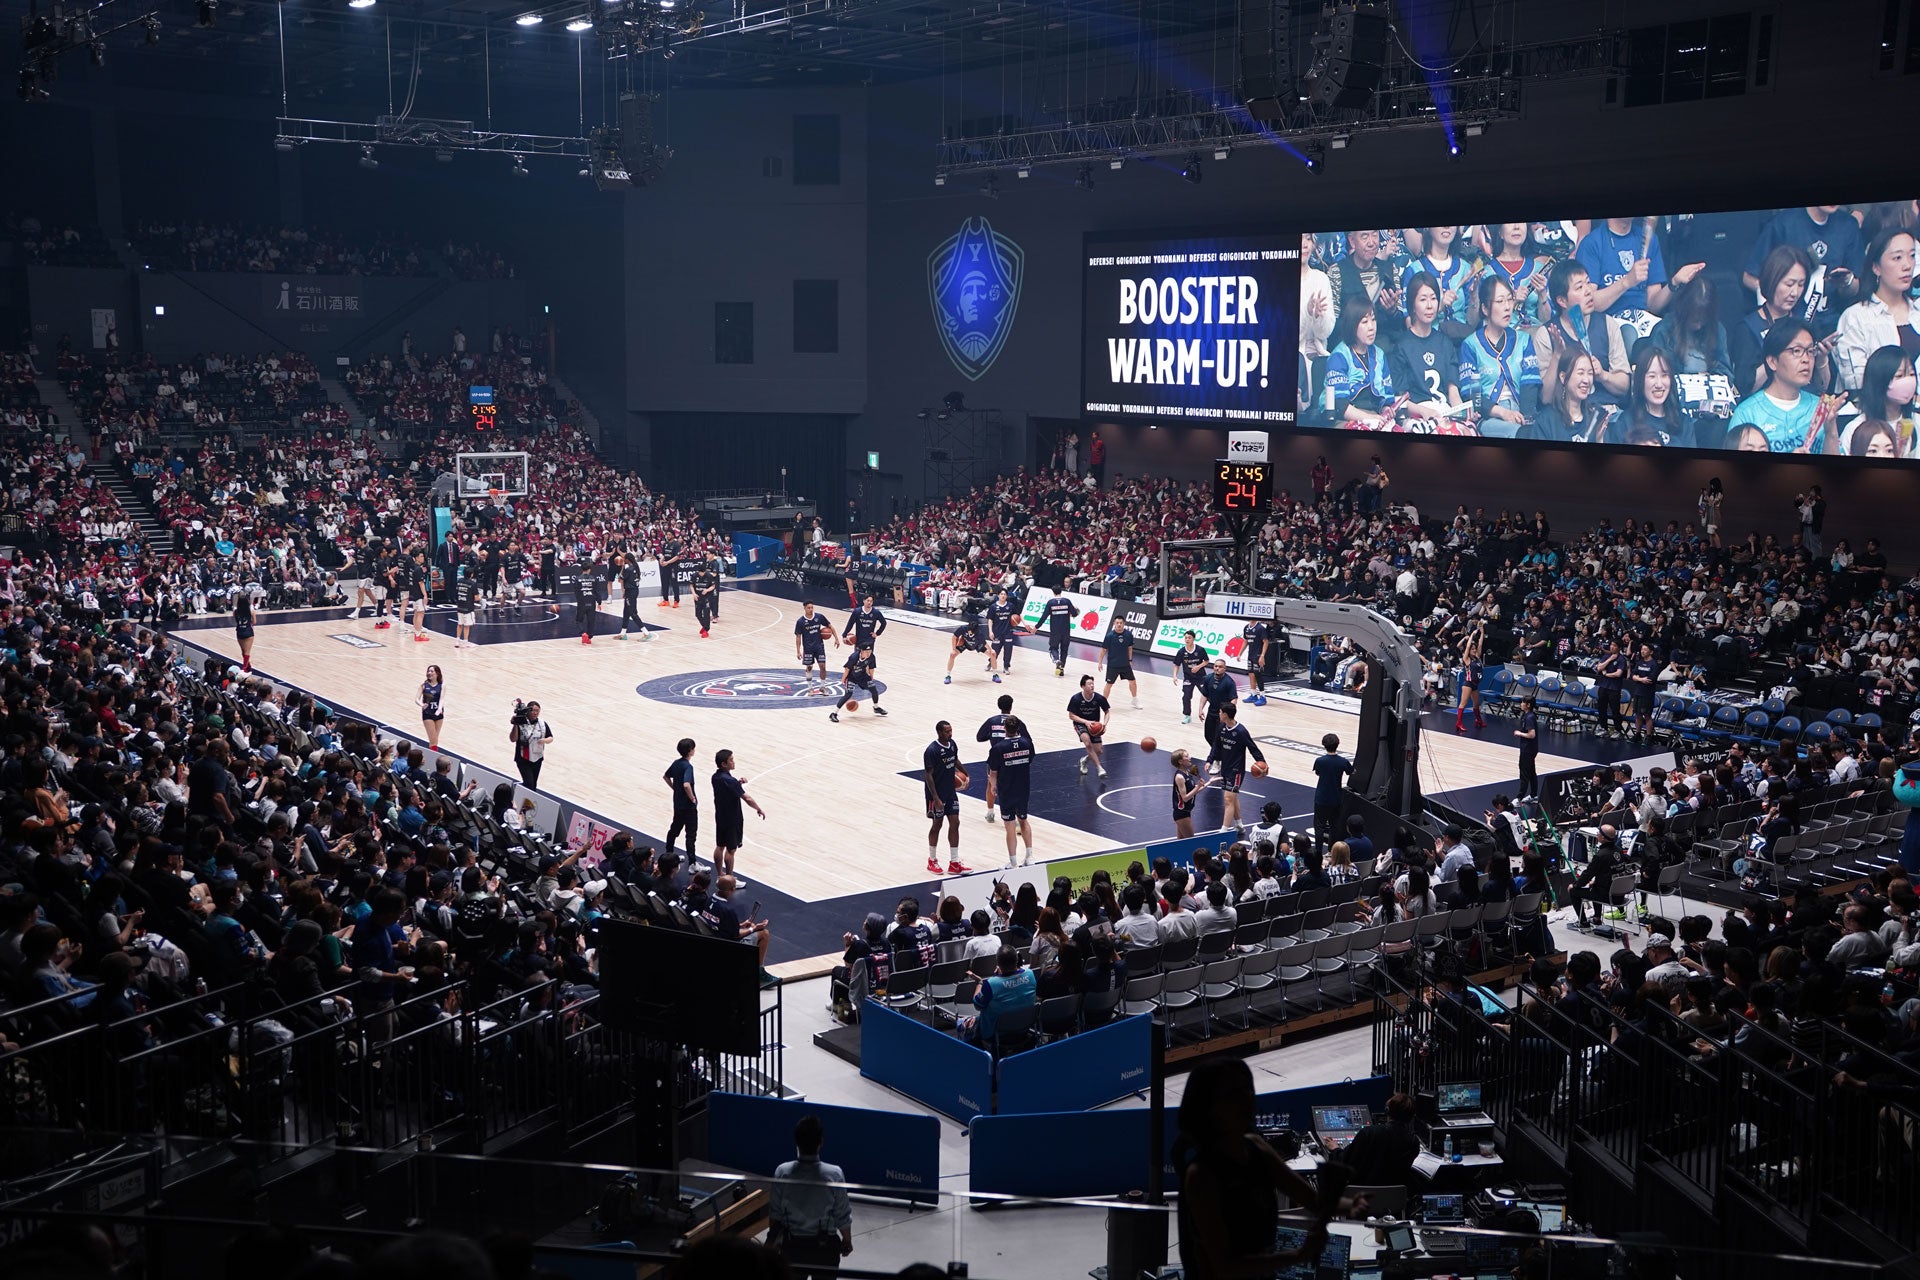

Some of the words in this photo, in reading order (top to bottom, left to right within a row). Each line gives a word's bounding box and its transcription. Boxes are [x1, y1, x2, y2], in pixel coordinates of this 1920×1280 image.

[1153, 253, 1187, 264] YOKOHAMA!
[1189, 252, 1217, 263] DEFENSE!
[1261, 249, 1299, 260] YOKOHAMA!
[296, 295, 359, 311] 石川酒販
[1119, 275, 1259, 325] BOOSTER
[1108, 338, 1270, 389] WARM-UP!
[472, 405, 497, 415] 21:45
[1225, 409, 1262, 420] YOKOHAMA!
[1263, 411, 1294, 421] DEFENSE!
[475, 414, 494, 431] 24
[1242, 445, 1265, 453] カネミツ
[1220, 465, 1263, 482] 21:45
[1226, 482, 1256, 507] 24
[1226, 601, 1245, 615] IHI
[1249, 605, 1272, 615] TURBO
[1126, 611, 1147, 625] CLUB
[1120, 1066, 1144, 1080] Nittaku
[886, 1169, 922, 1183] Nittaku
